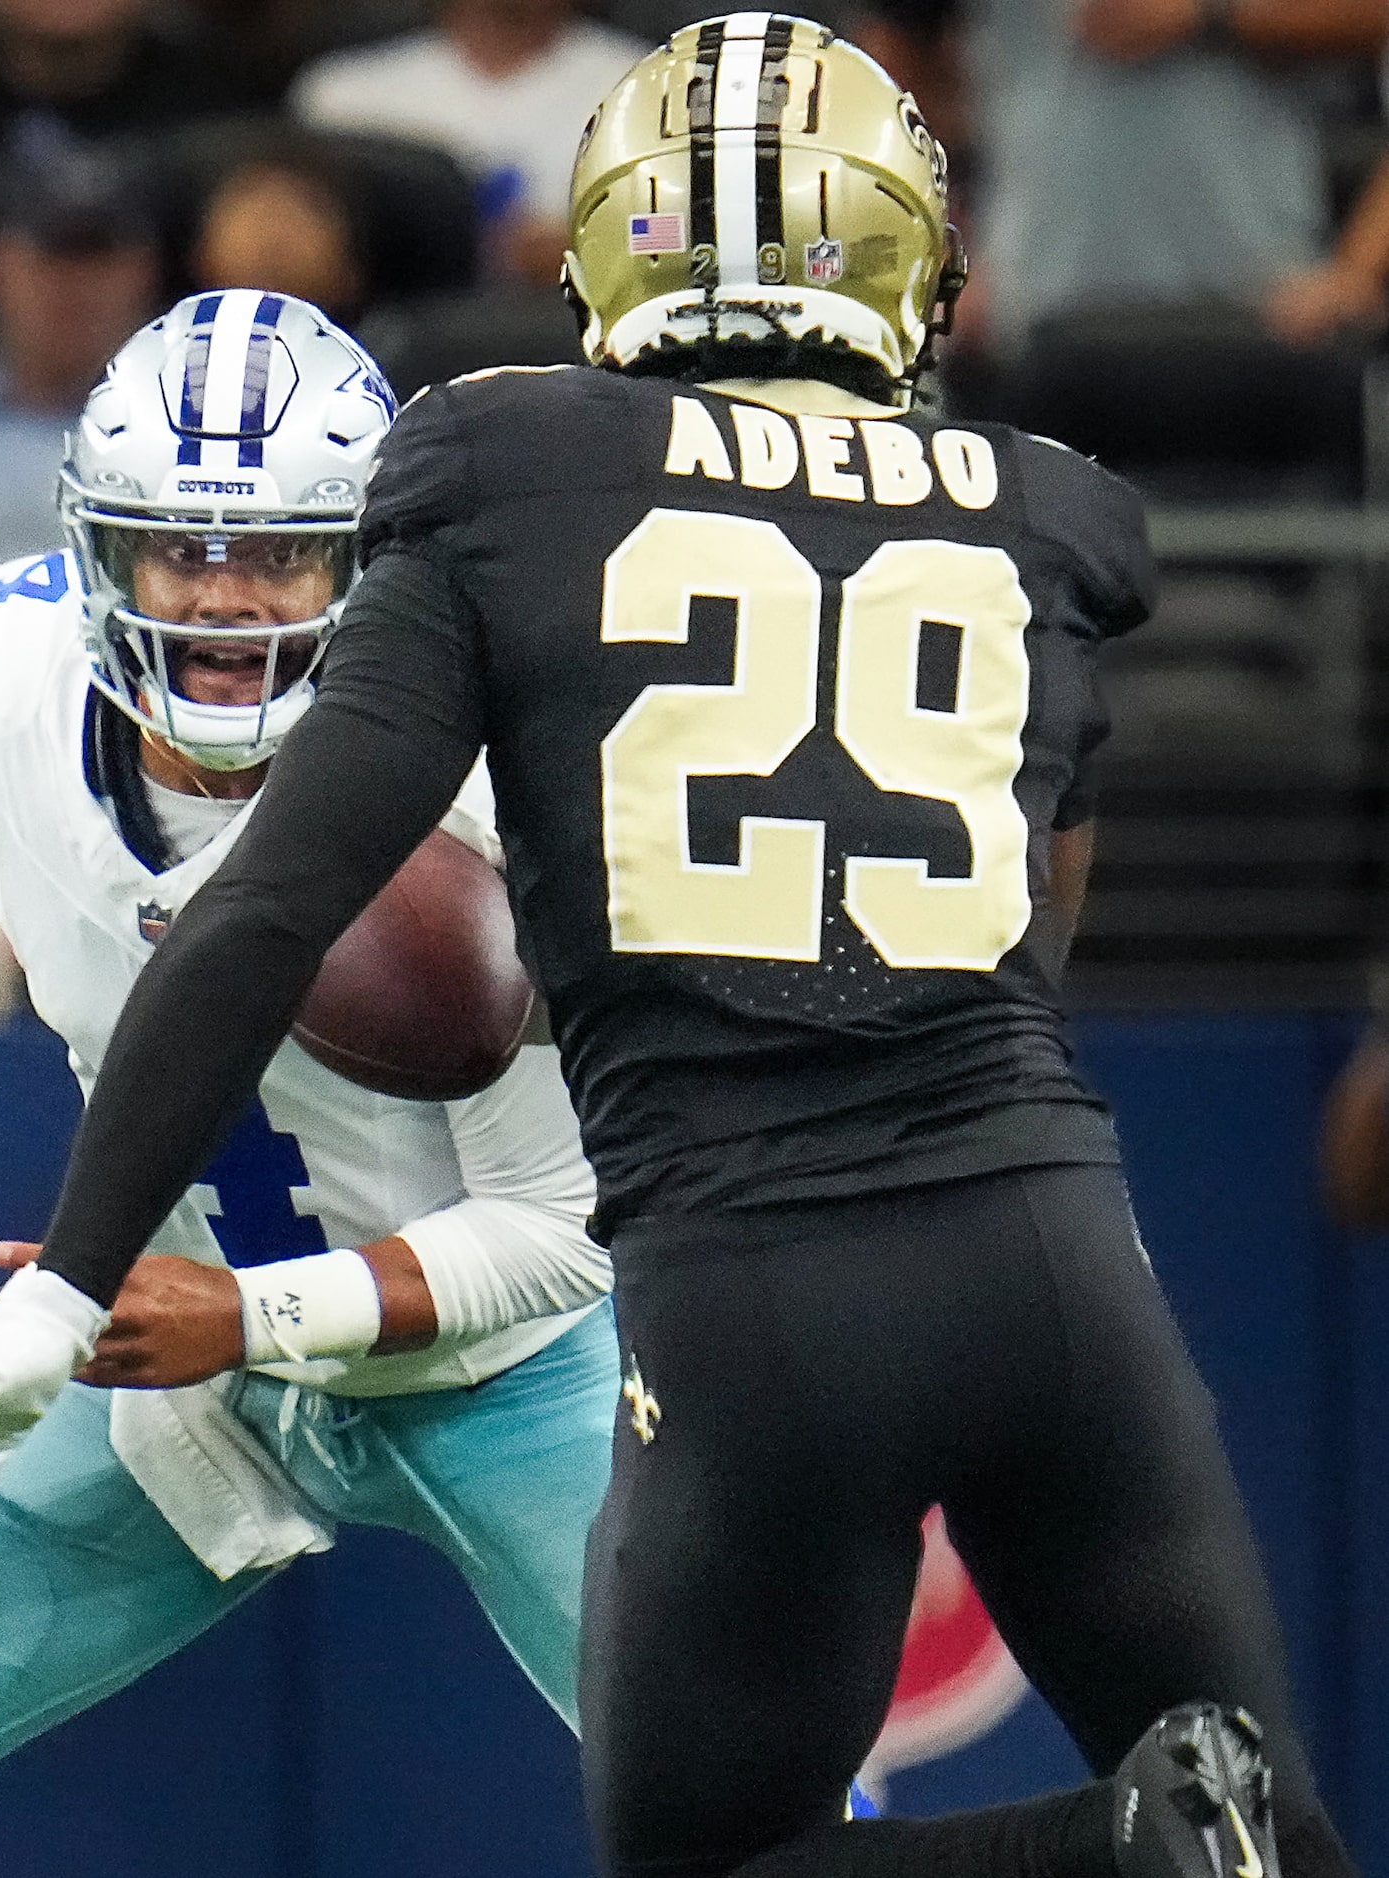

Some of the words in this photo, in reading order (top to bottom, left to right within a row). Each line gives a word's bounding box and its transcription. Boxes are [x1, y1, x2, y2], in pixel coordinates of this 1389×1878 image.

[178, 480, 255, 495] COWBOYS
[665, 396, 998, 509] ADEBO
[600, 507, 1032, 971] 29
